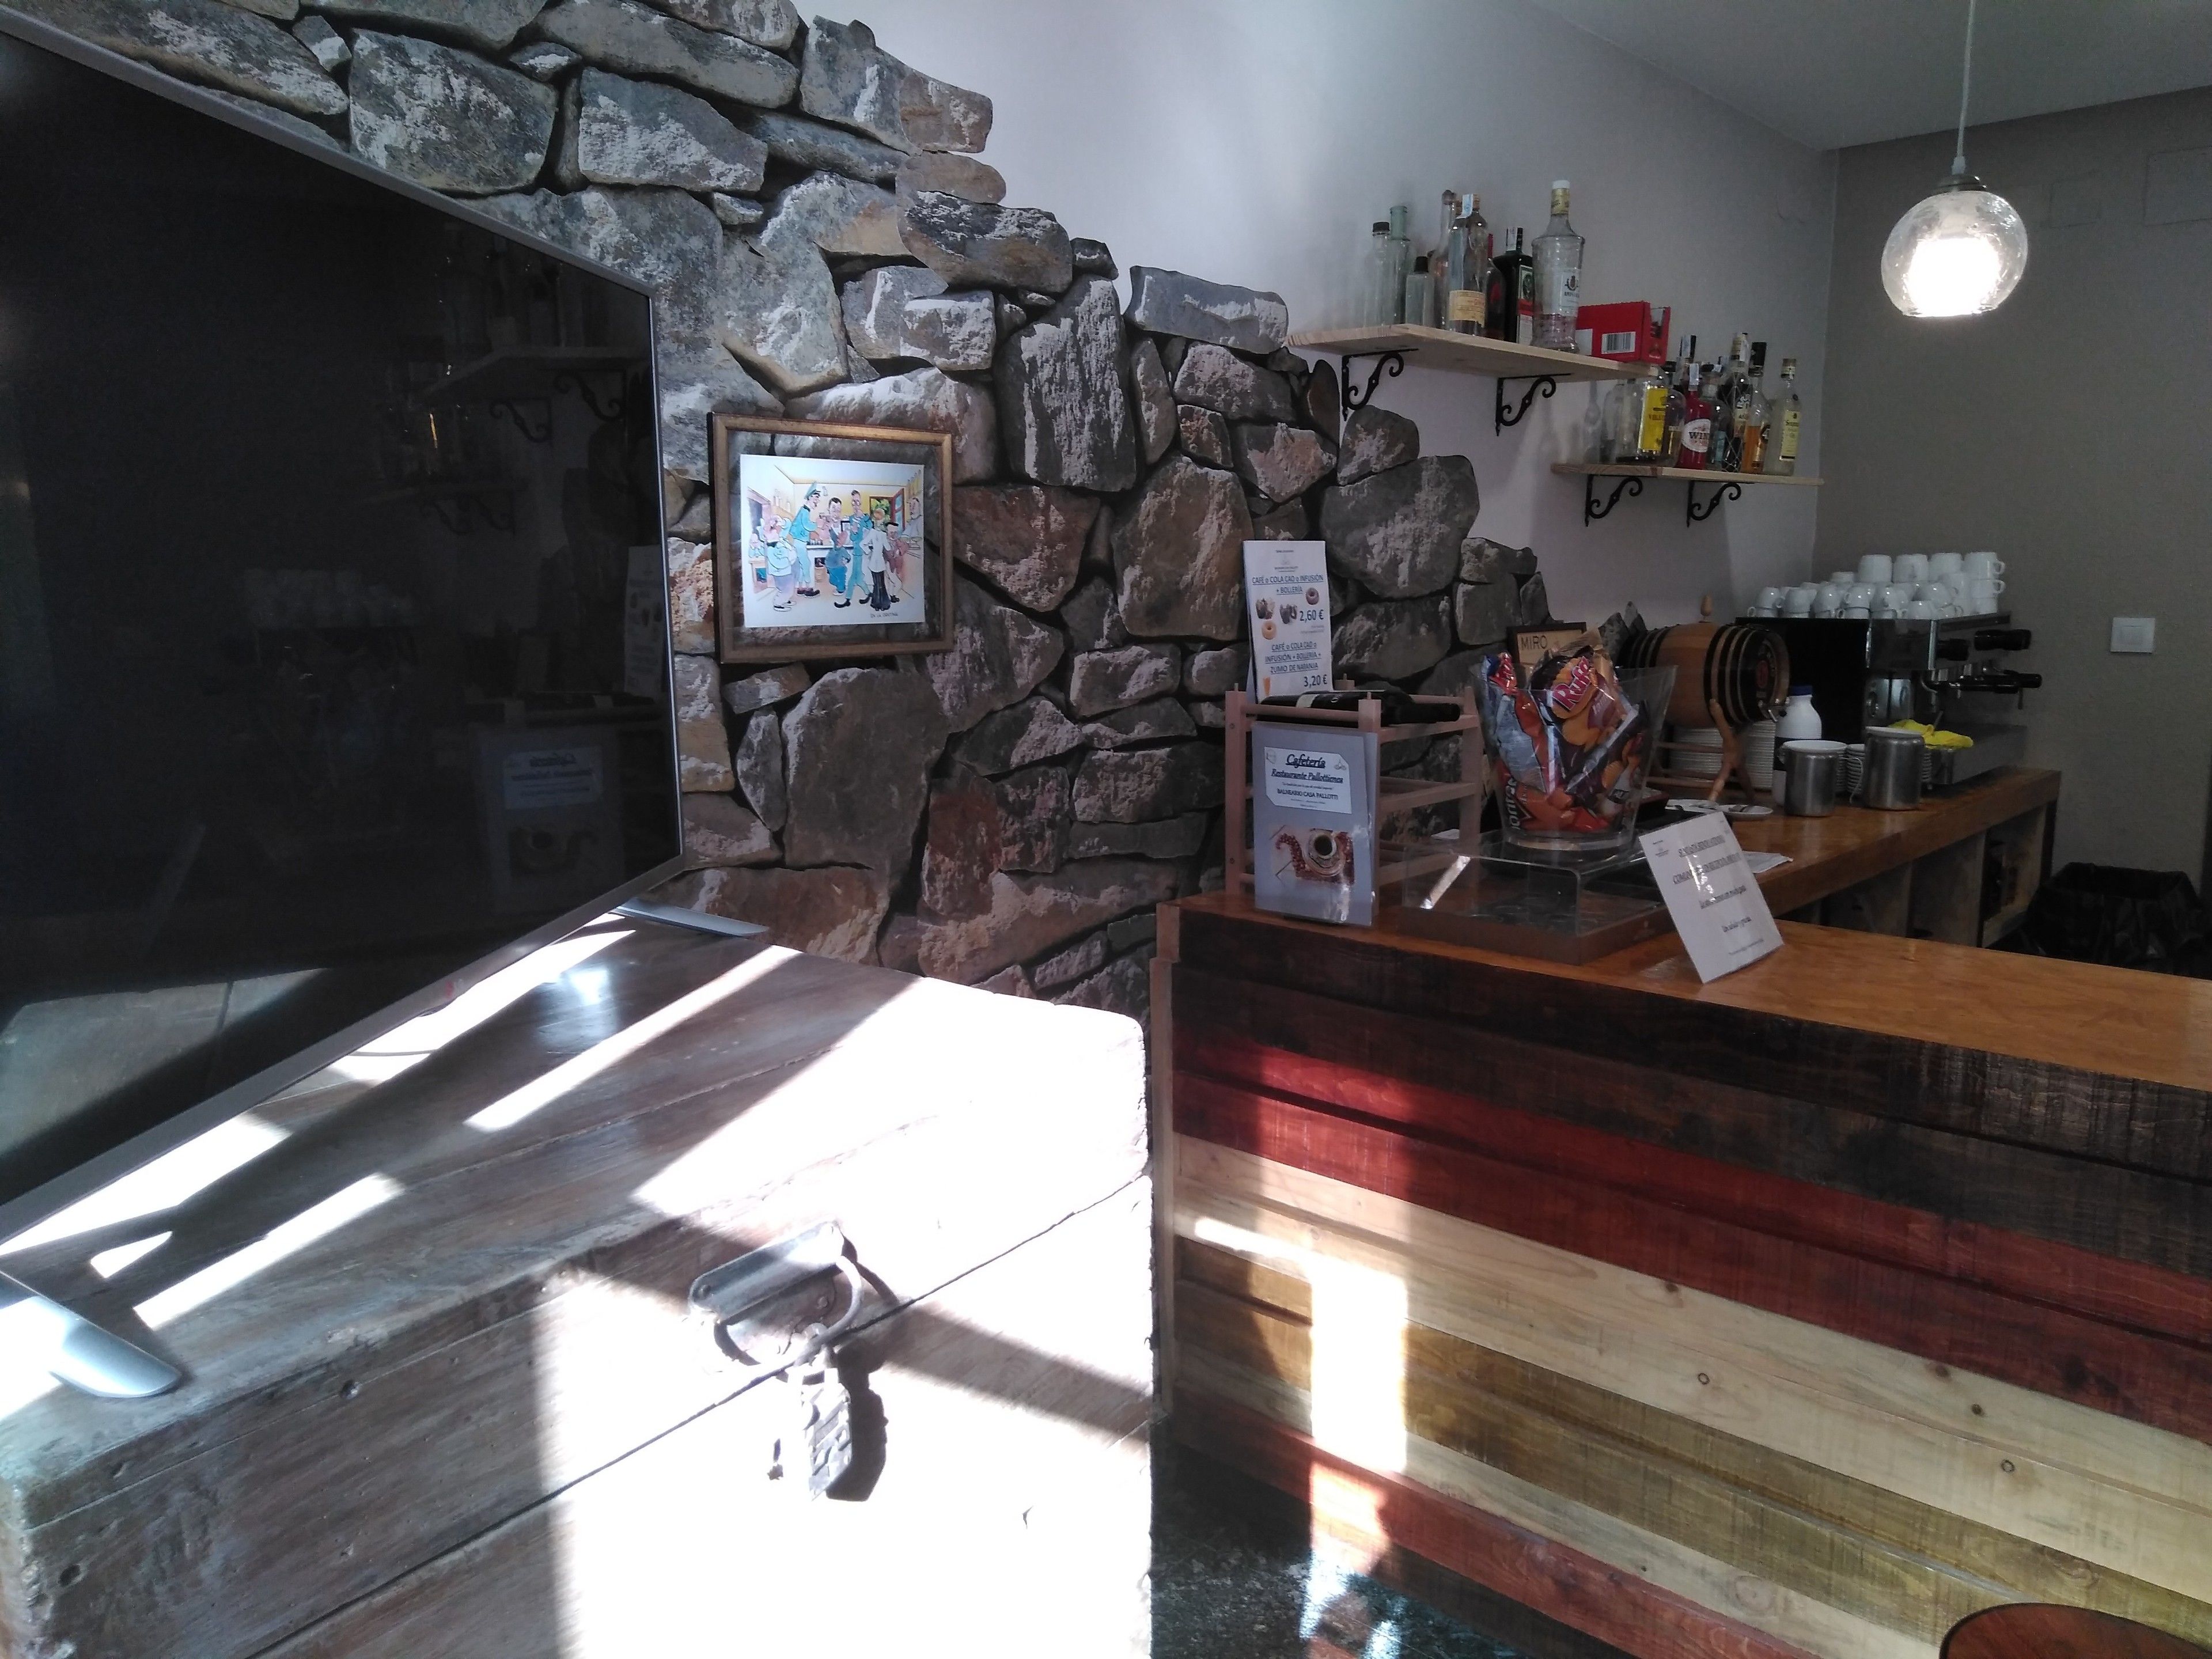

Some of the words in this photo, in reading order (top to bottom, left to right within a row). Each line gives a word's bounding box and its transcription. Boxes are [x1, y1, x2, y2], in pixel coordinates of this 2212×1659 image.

[1300, 609, 1316, 623] 2,60
[1318, 609, 1324, 620] €
[1272, 642, 1285, 650] CAFÉ
[1270, 665, 1287, 673] ZUMO
[1304, 675, 1321, 688] 3,20
[1323, 674, 1327, 684] €
[1286, 753, 1326, 768] Cafetería
[1271, 768, 1307, 779] Restaurante
